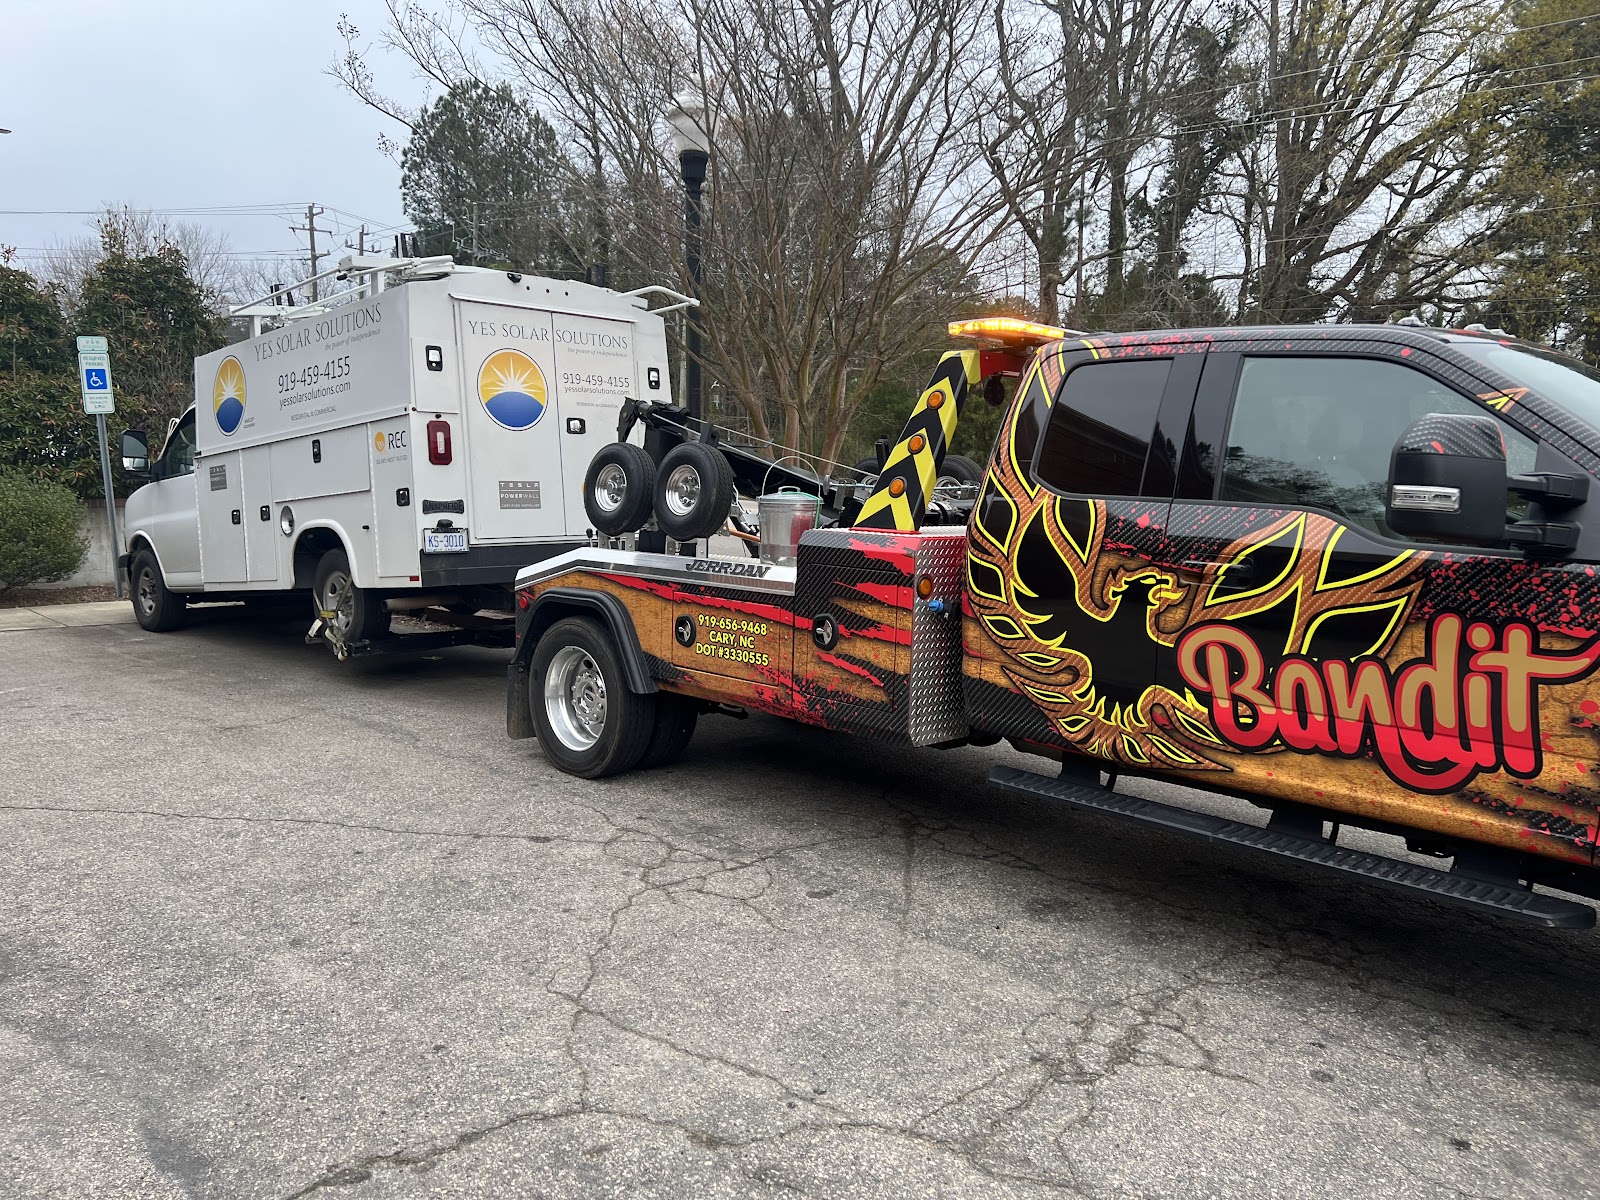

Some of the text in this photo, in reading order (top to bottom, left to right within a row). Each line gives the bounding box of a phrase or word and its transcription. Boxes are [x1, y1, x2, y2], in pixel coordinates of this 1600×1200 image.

[254, 302, 382, 362] YES SOLAR SOLUTIONS
[468, 320, 628, 350] YES SOLAR SOLUTIONS
[278, 355, 351, 394] 919-459-4155
[563, 372, 630, 388] 919-459-4155
[279, 381, 351, 411] yessolarsolutions.com
[564, 386, 630, 395] yessolarsolutions.com
[388, 430, 407, 450] REC
[428, 534, 464, 548] KS-3010
[698, 614, 768, 636] 919-656-9468
[709, 630, 755, 649] CARY, NC
[696, 642, 769, 666] DOT #3330555
[1175, 611, 1600, 793] Bandit
